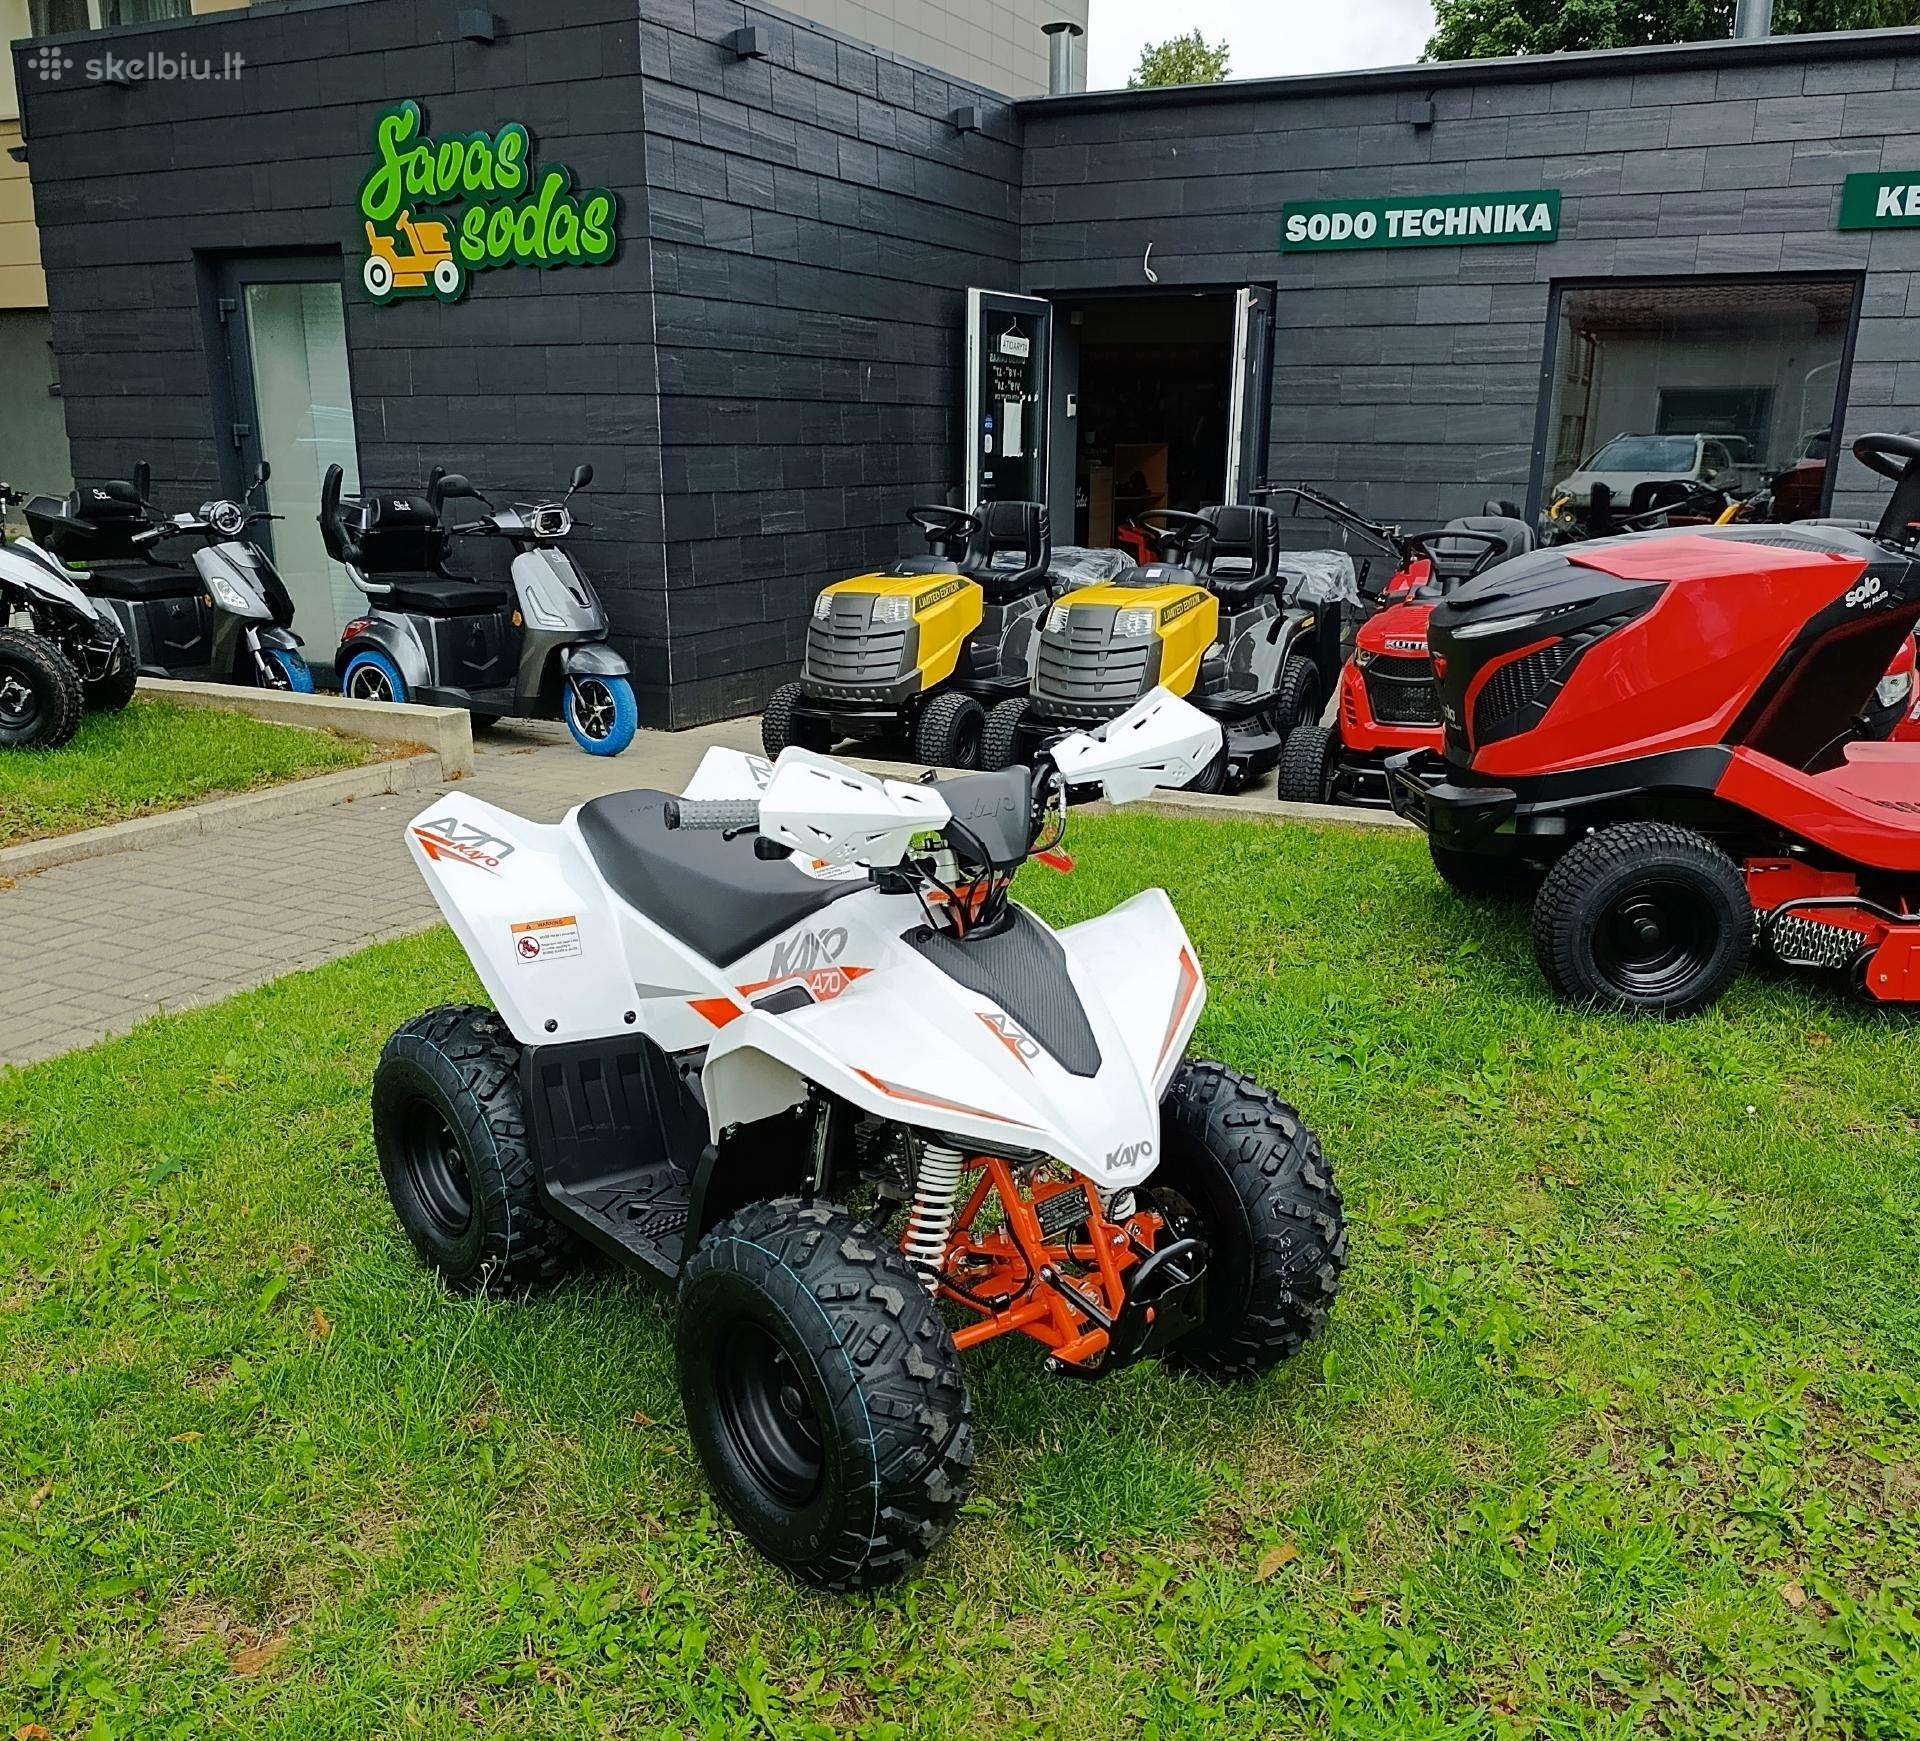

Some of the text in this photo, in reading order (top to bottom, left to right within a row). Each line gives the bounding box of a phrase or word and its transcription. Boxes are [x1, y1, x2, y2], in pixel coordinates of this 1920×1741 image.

[361, 108, 522, 221] Savas
[460, 172, 609, 261] sodas
[1875, 185, 1920, 217] KE
[1285, 203, 1552, 242] SODO TECHNIKA
[918, 581, 960, 609] LIMITED EDITION
[1163, 593, 1201, 622] LIMITED EDITION
[1845, 577, 1881, 608] solo
[811, 971, 841, 994] A70
[1105, 1140, 1153, 1171] KAYO
